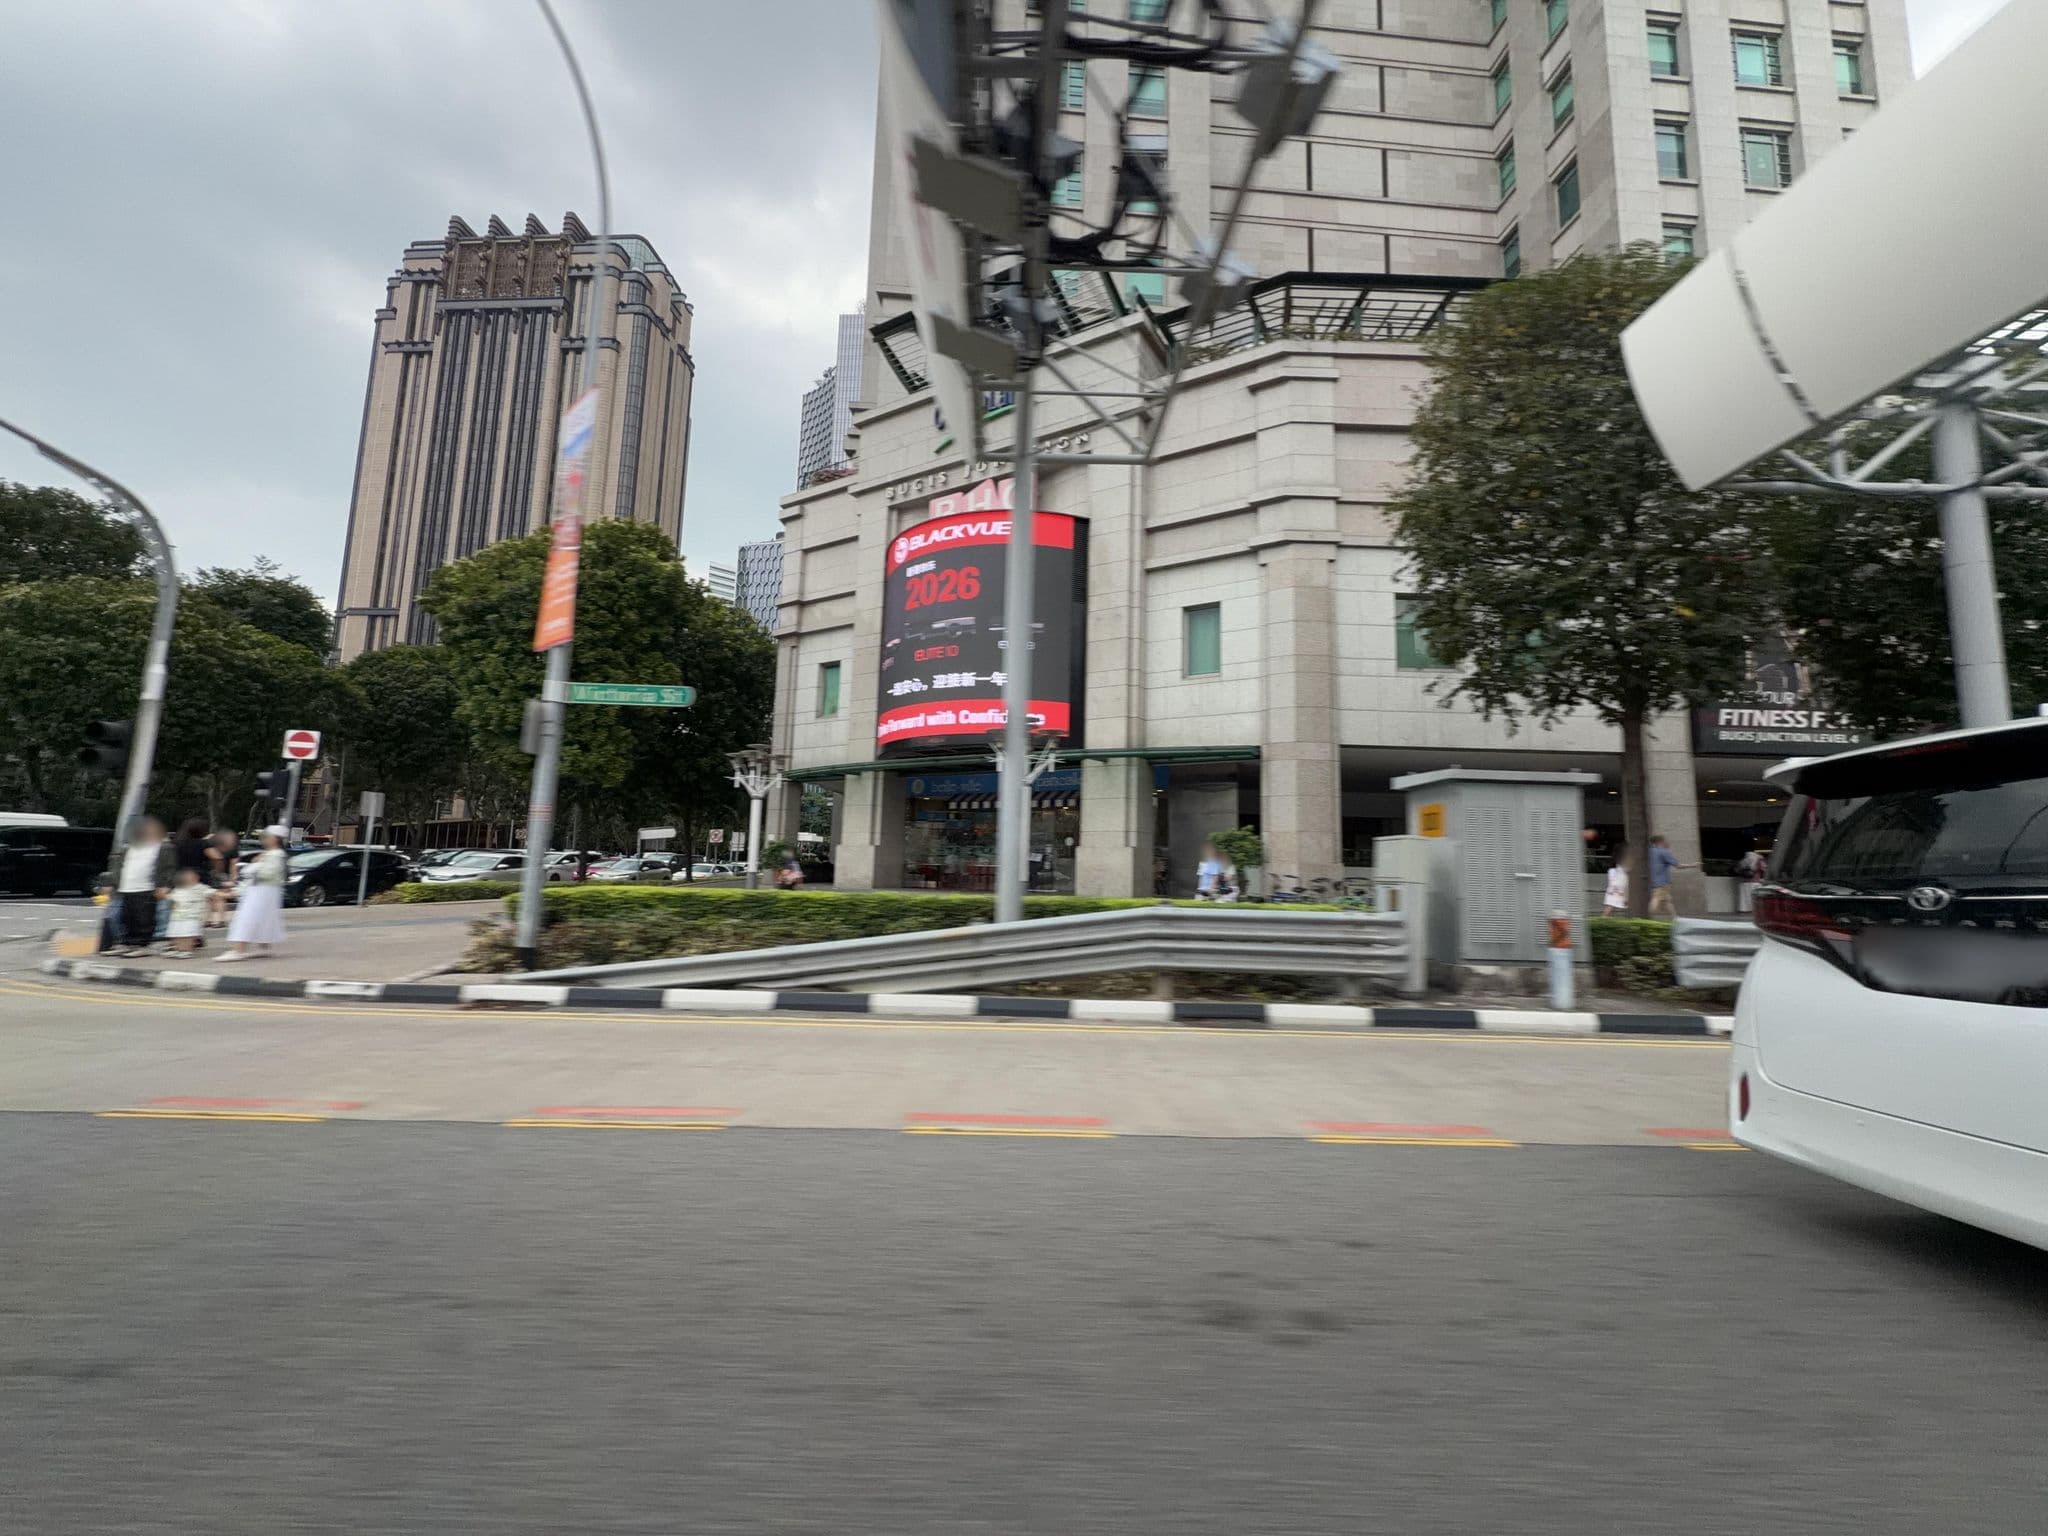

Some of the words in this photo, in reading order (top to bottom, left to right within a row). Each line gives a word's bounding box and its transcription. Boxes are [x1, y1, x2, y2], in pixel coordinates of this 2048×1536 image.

[885, 471, 948, 499] BUGIS
[909, 521, 1012, 550] BLACKVUE
[904, 566, 981, 611] 2026
[926, 710, 956, 726] with
[1718, 708, 1809, 728] FITNESS
[1719, 731, 1755, 742] BUGIS
[1756, 732, 1811, 743] JUNCTION
[1814, 733, 1848, 743] LEVEL
[1849, 733, 1860, 744] 4
